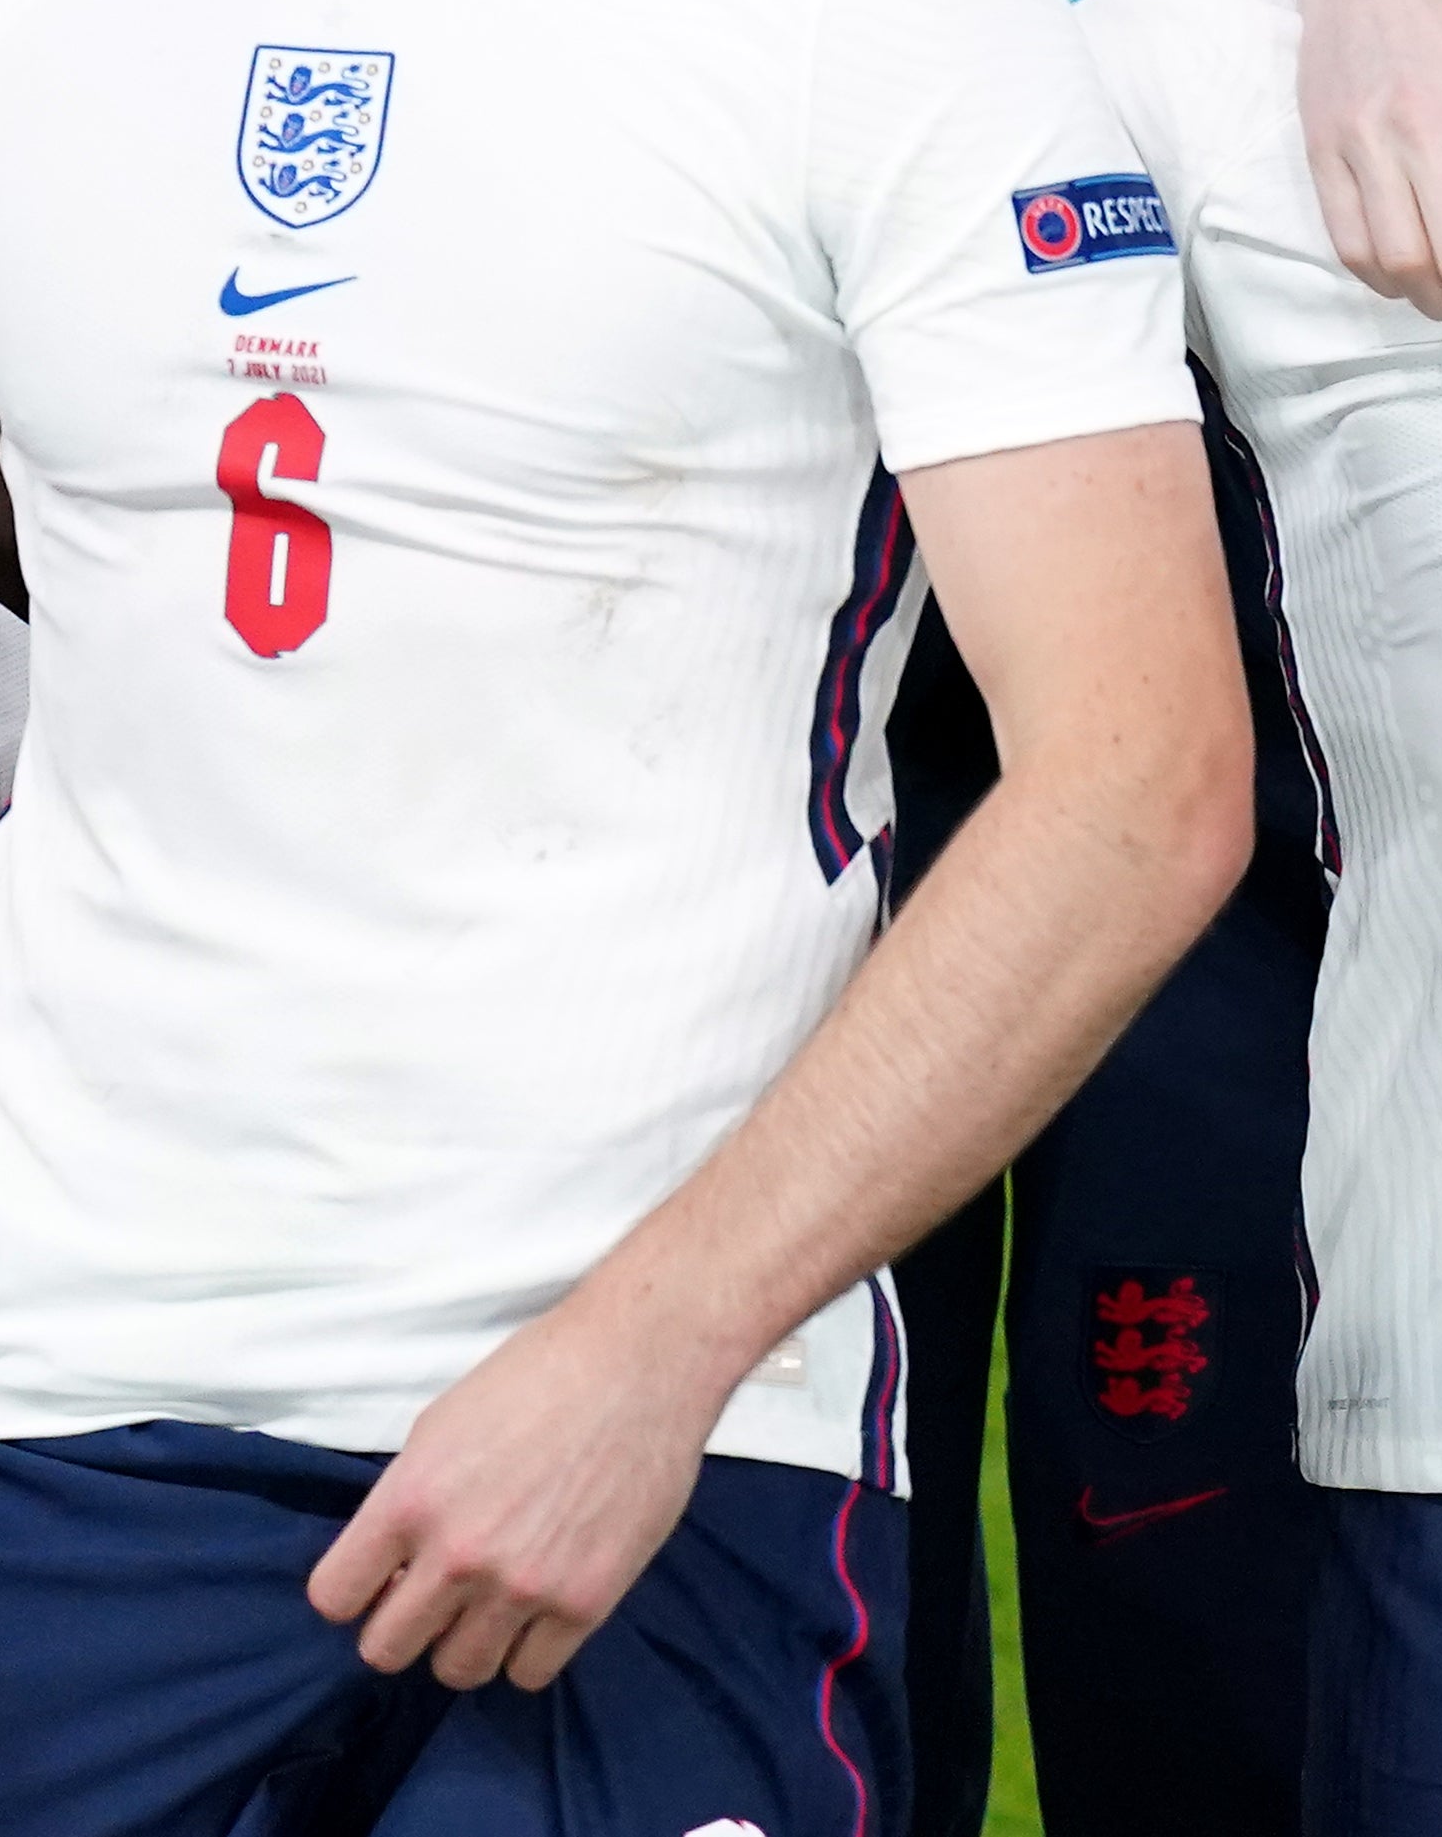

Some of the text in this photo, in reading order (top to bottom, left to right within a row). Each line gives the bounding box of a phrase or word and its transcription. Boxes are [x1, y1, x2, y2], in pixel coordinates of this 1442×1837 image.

[235, 334, 320, 358] DENMARK
[227, 358, 326, 385] 7 JULY 2021
[215, 392, 332, 659] 6
